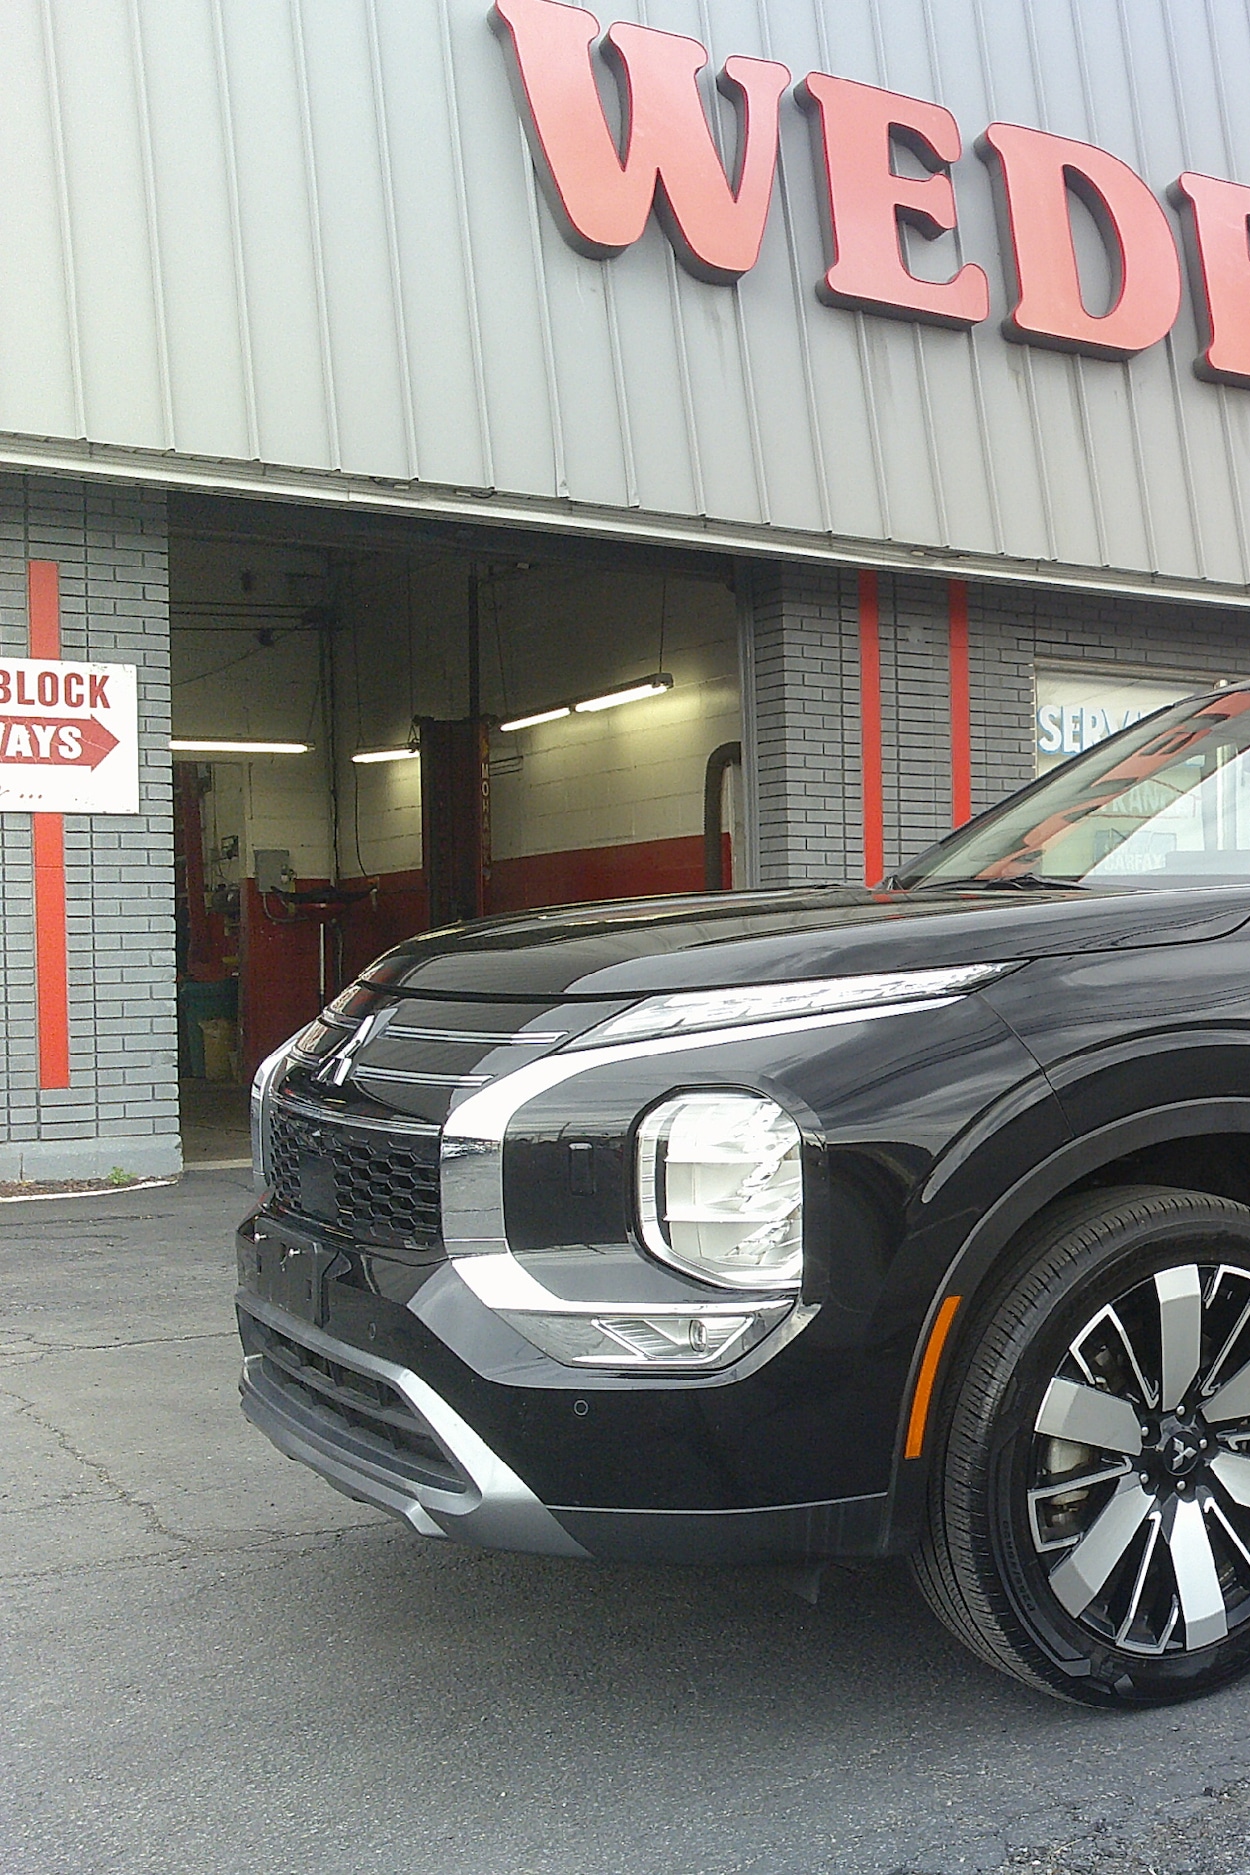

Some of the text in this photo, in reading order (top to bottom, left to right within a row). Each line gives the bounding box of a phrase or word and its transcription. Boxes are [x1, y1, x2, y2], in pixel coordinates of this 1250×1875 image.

[0, 669, 111, 709] BLOCK
[0, 721, 83, 760] AYS
[1037, 704, 1144, 756] SERV
